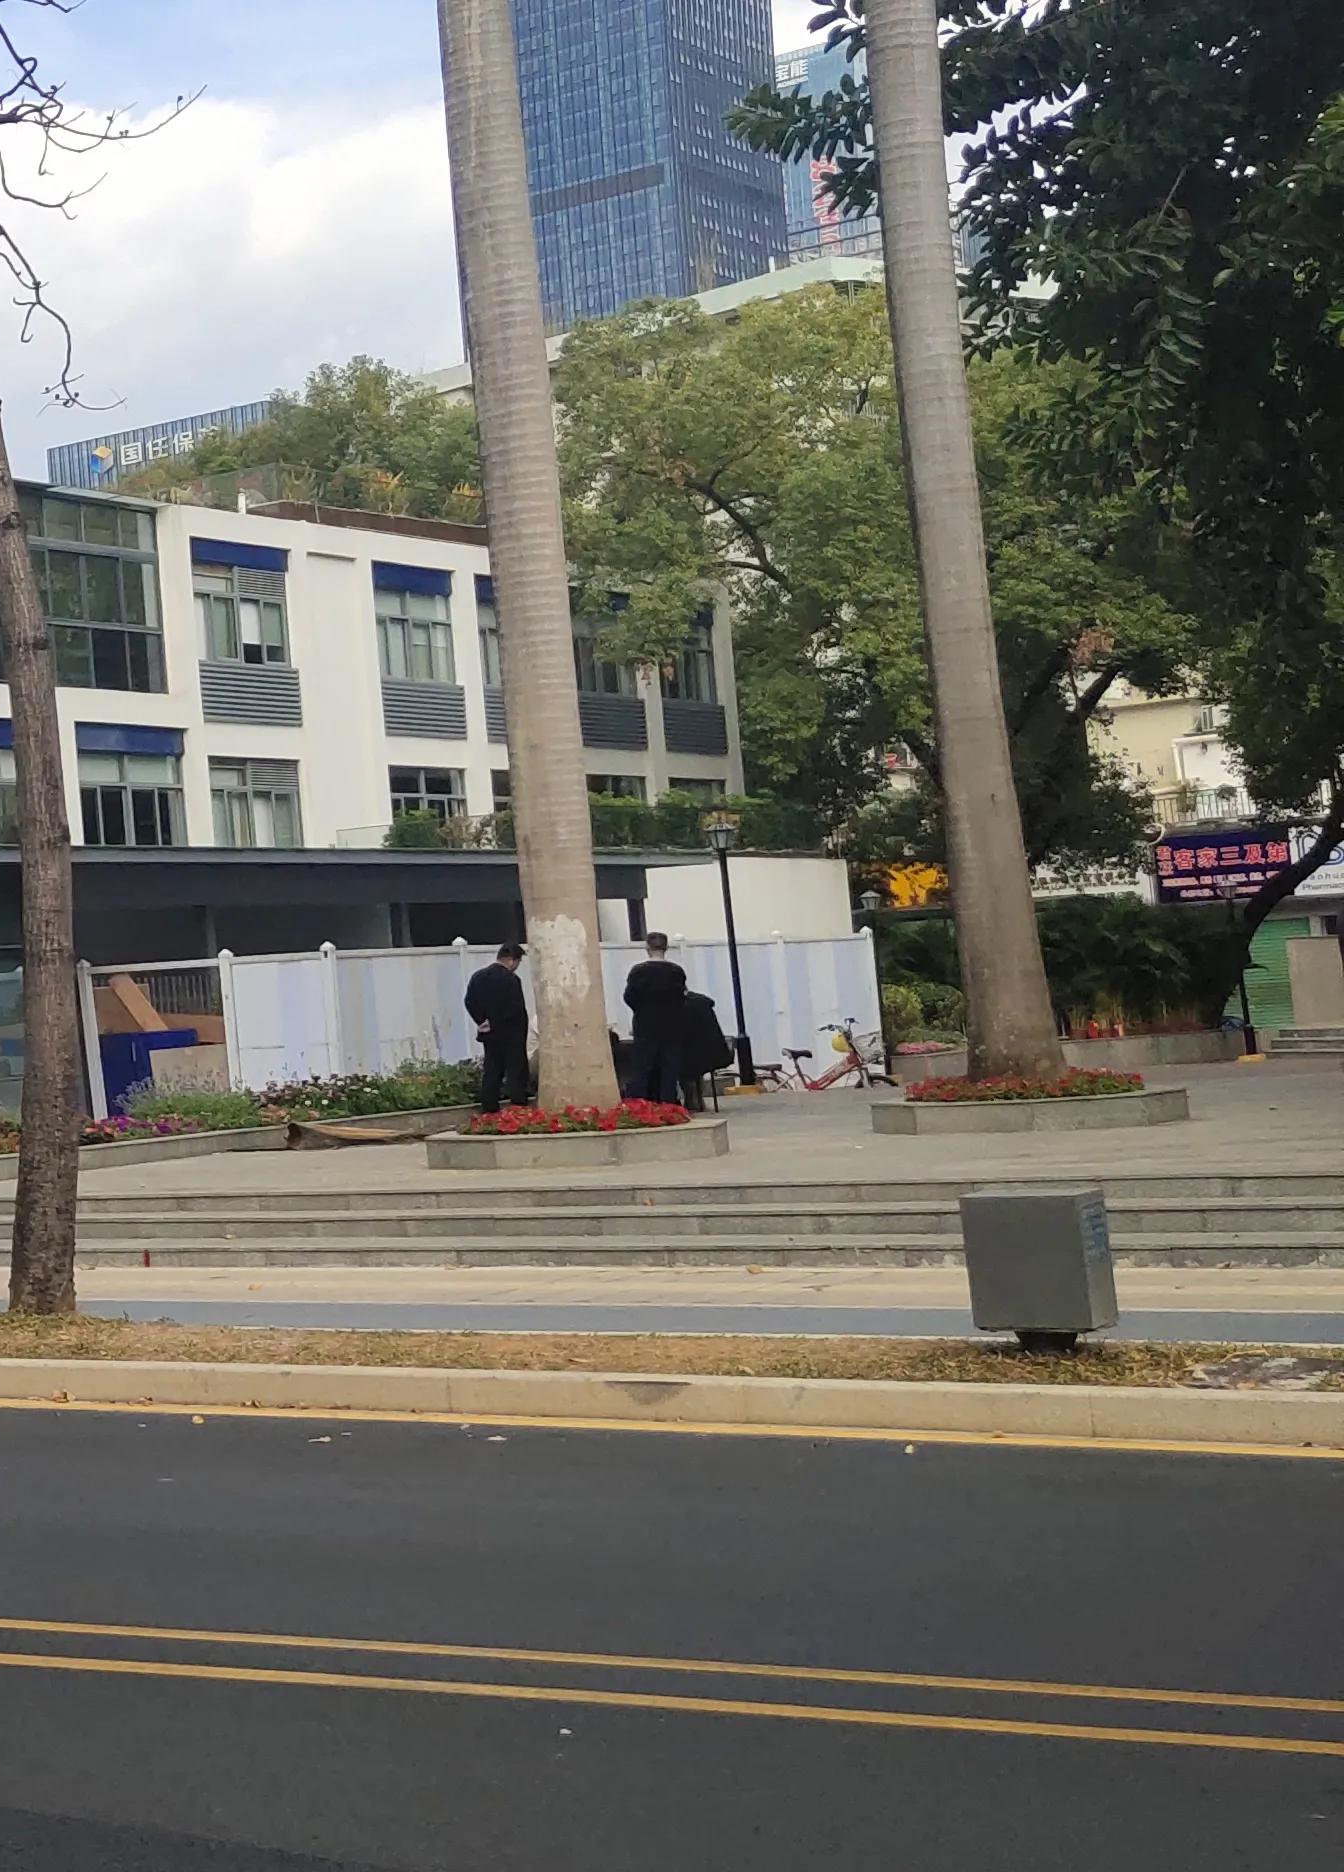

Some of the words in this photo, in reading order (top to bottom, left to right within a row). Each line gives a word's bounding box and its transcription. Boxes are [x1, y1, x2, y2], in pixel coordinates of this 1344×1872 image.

[1173, 841, 1289, 871] 客家三及第
